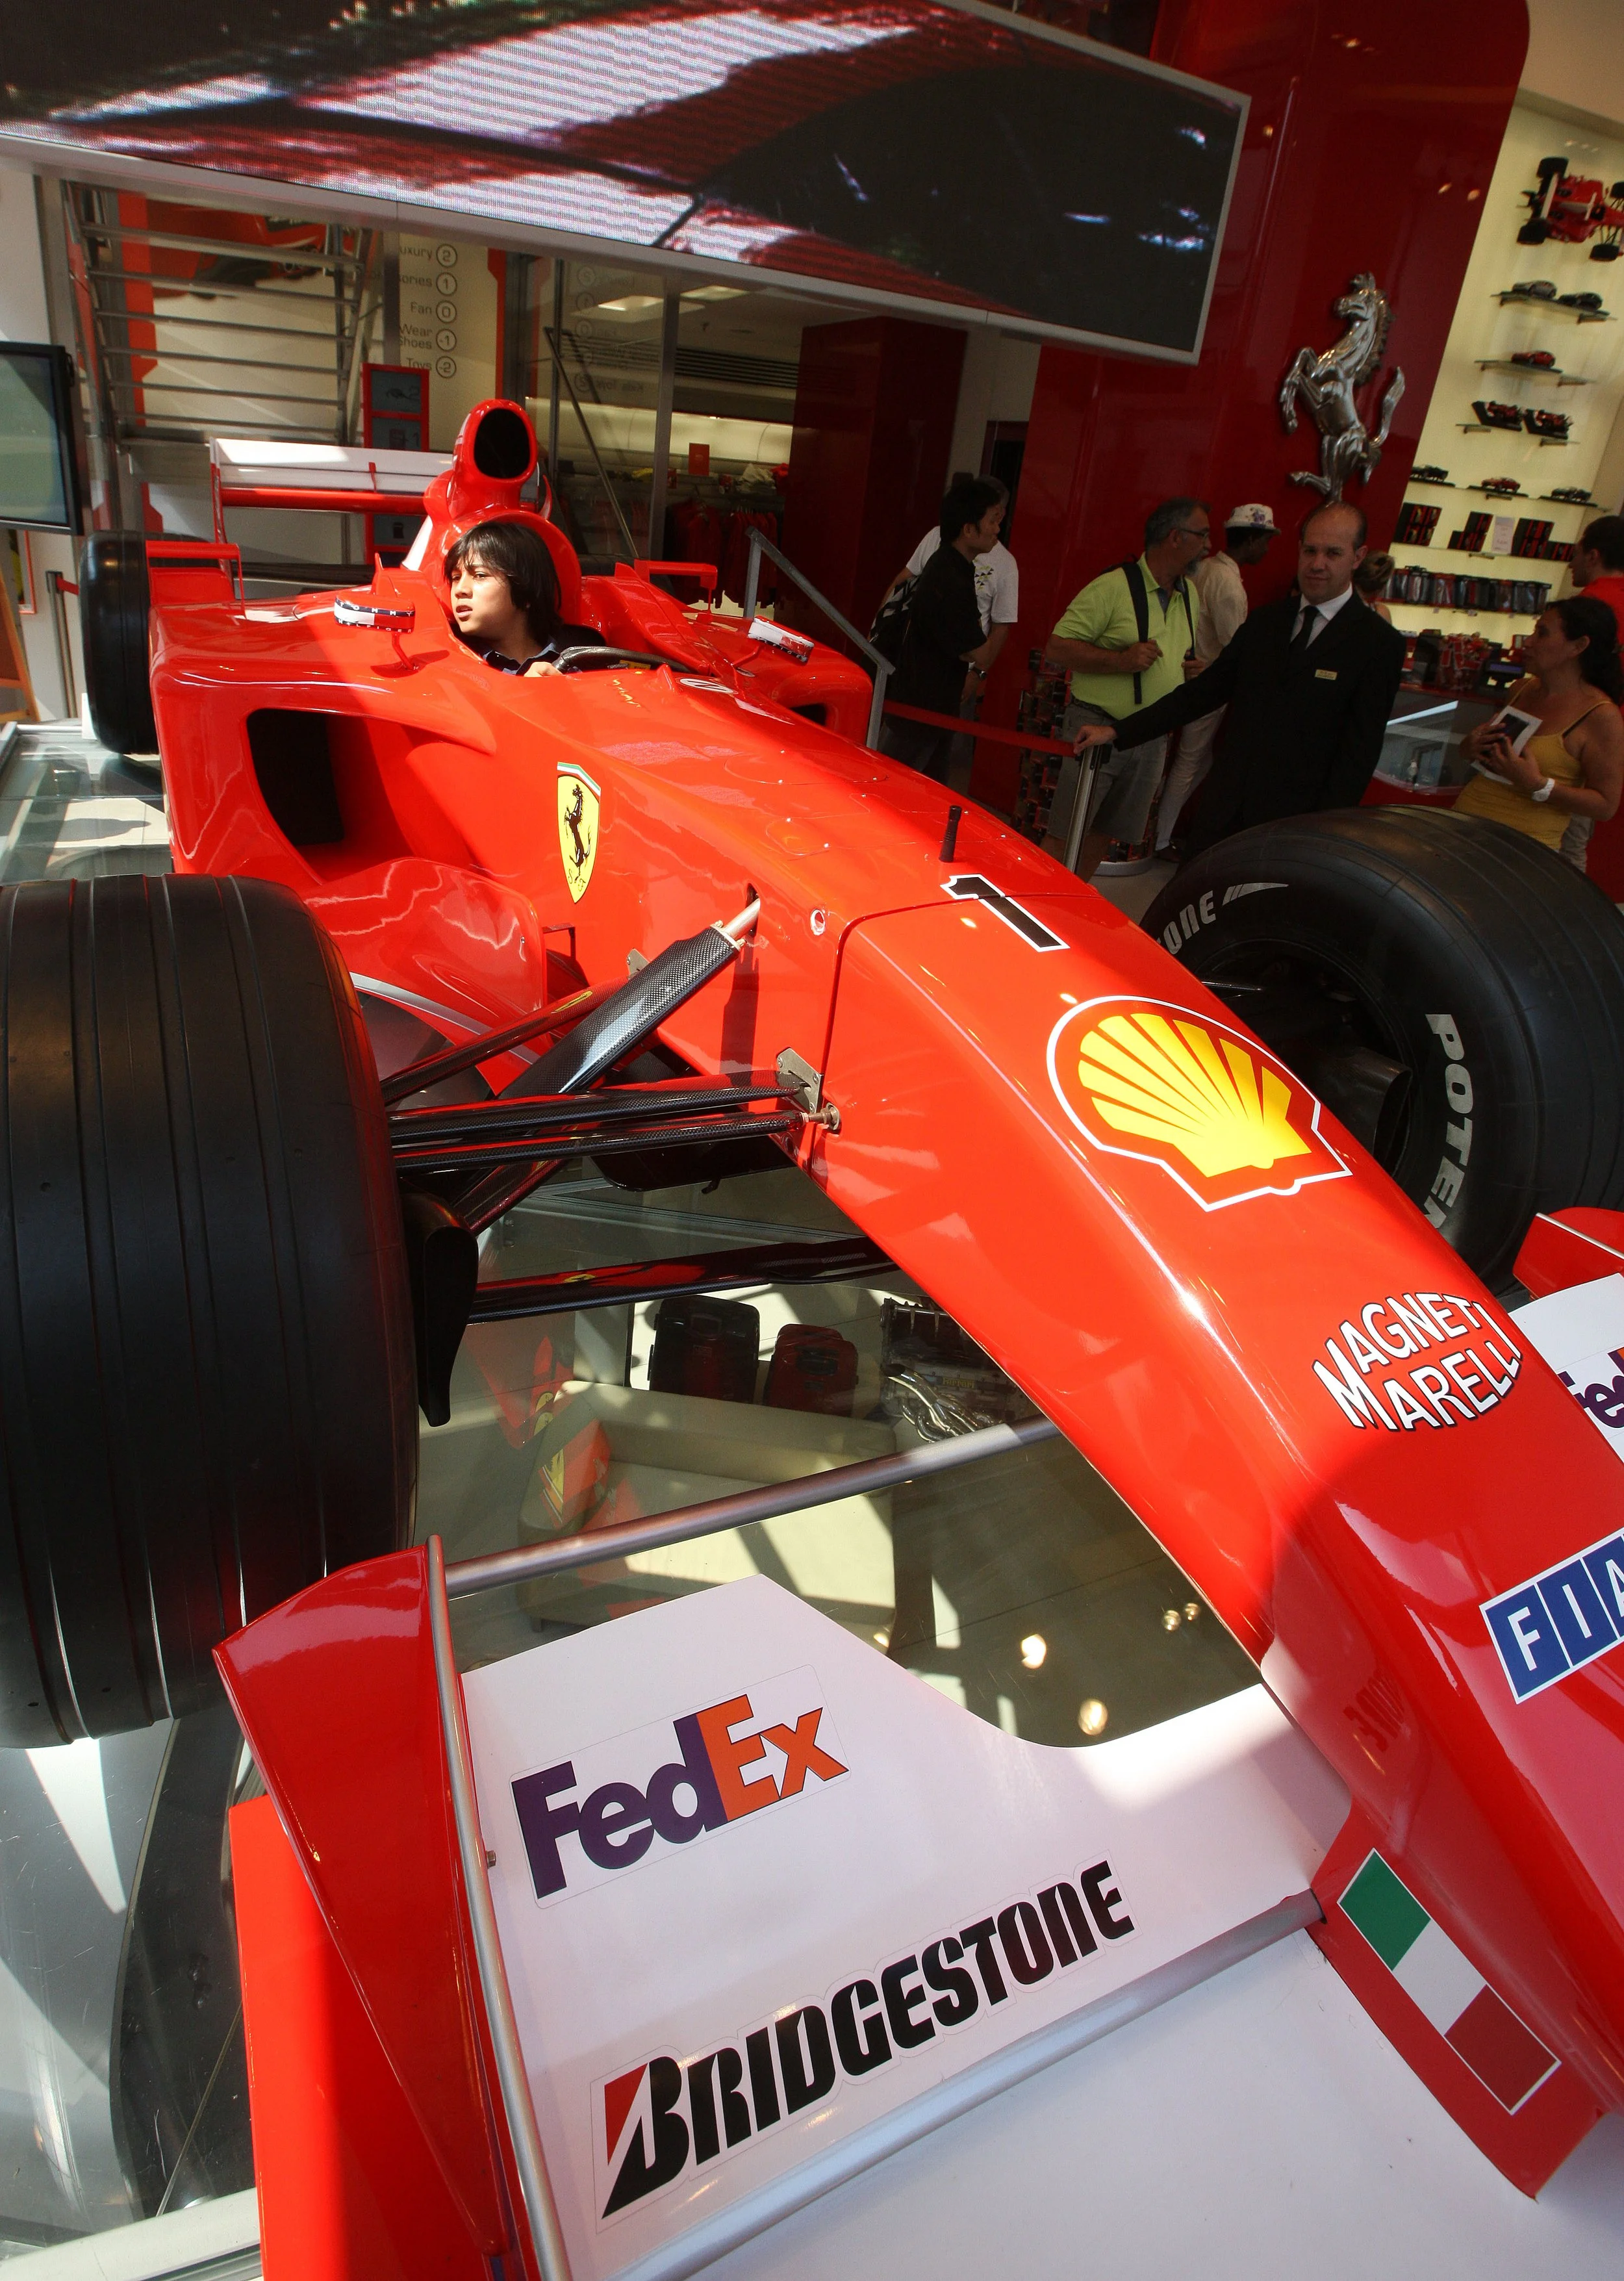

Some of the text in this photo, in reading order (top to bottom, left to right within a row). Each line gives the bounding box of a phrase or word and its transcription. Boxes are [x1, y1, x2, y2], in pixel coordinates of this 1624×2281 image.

[400, 248, 432, 260] uxury
[400, 275, 432, 287] ories
[411, 301, 432, 314] Fan
[400, 324, 433, 337] Wear
[340, 602, 412, 617] TOMMY
[940, 874, 1071, 952] 1
[1157, 890, 1217, 955] ONE
[1312, 1325, 1522, 1431] MARELLI
[512, 1694, 850, 1900] FedEx
[602, 1860, 1135, 2219] BRIDGESTONE
